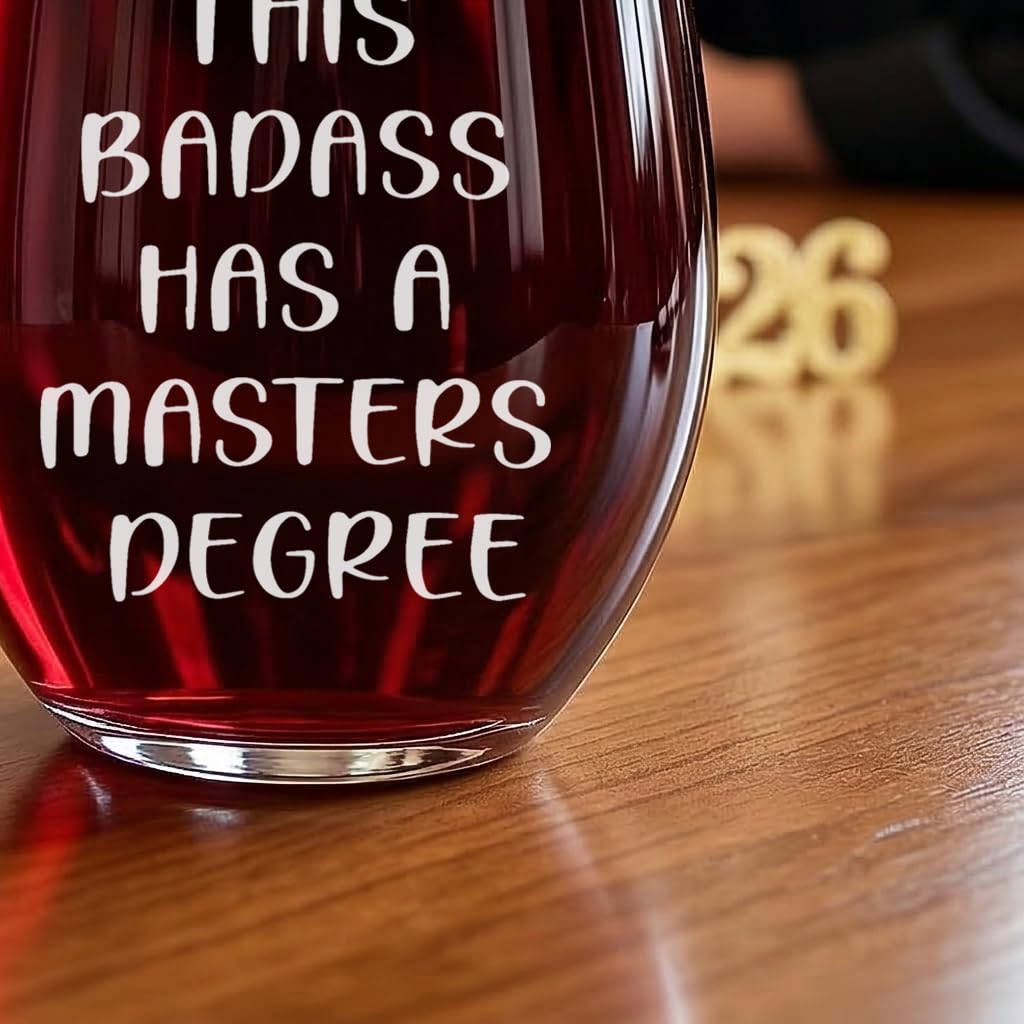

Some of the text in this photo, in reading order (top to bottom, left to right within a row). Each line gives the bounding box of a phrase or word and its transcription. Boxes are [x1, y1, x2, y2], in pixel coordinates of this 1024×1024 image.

[81, 109, 510, 203] BADASS
[140, 242, 450, 333] HAS A
[40, 377, 552, 469] MASTERS
[110, 510, 527, 602] DEGREE
